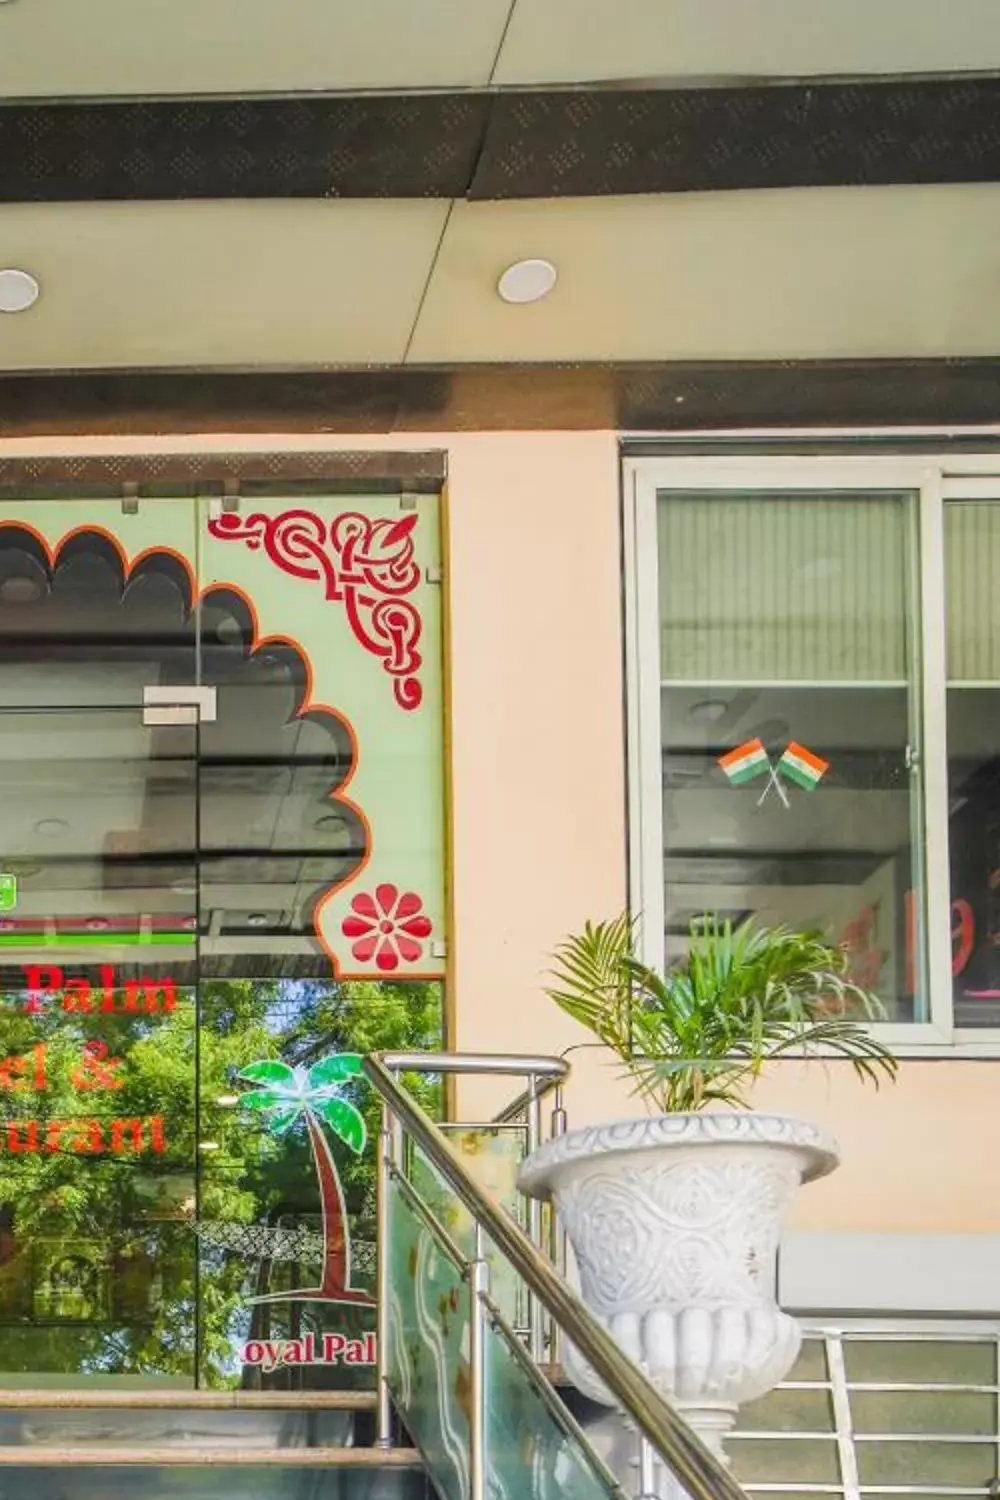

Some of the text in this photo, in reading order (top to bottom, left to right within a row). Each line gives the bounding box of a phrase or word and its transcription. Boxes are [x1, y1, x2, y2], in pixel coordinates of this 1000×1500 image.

[22, 965, 177, 1013] Palm
[72, 1041, 125, 1090] &
[240, 1332, 377, 1372] oyal Pal
